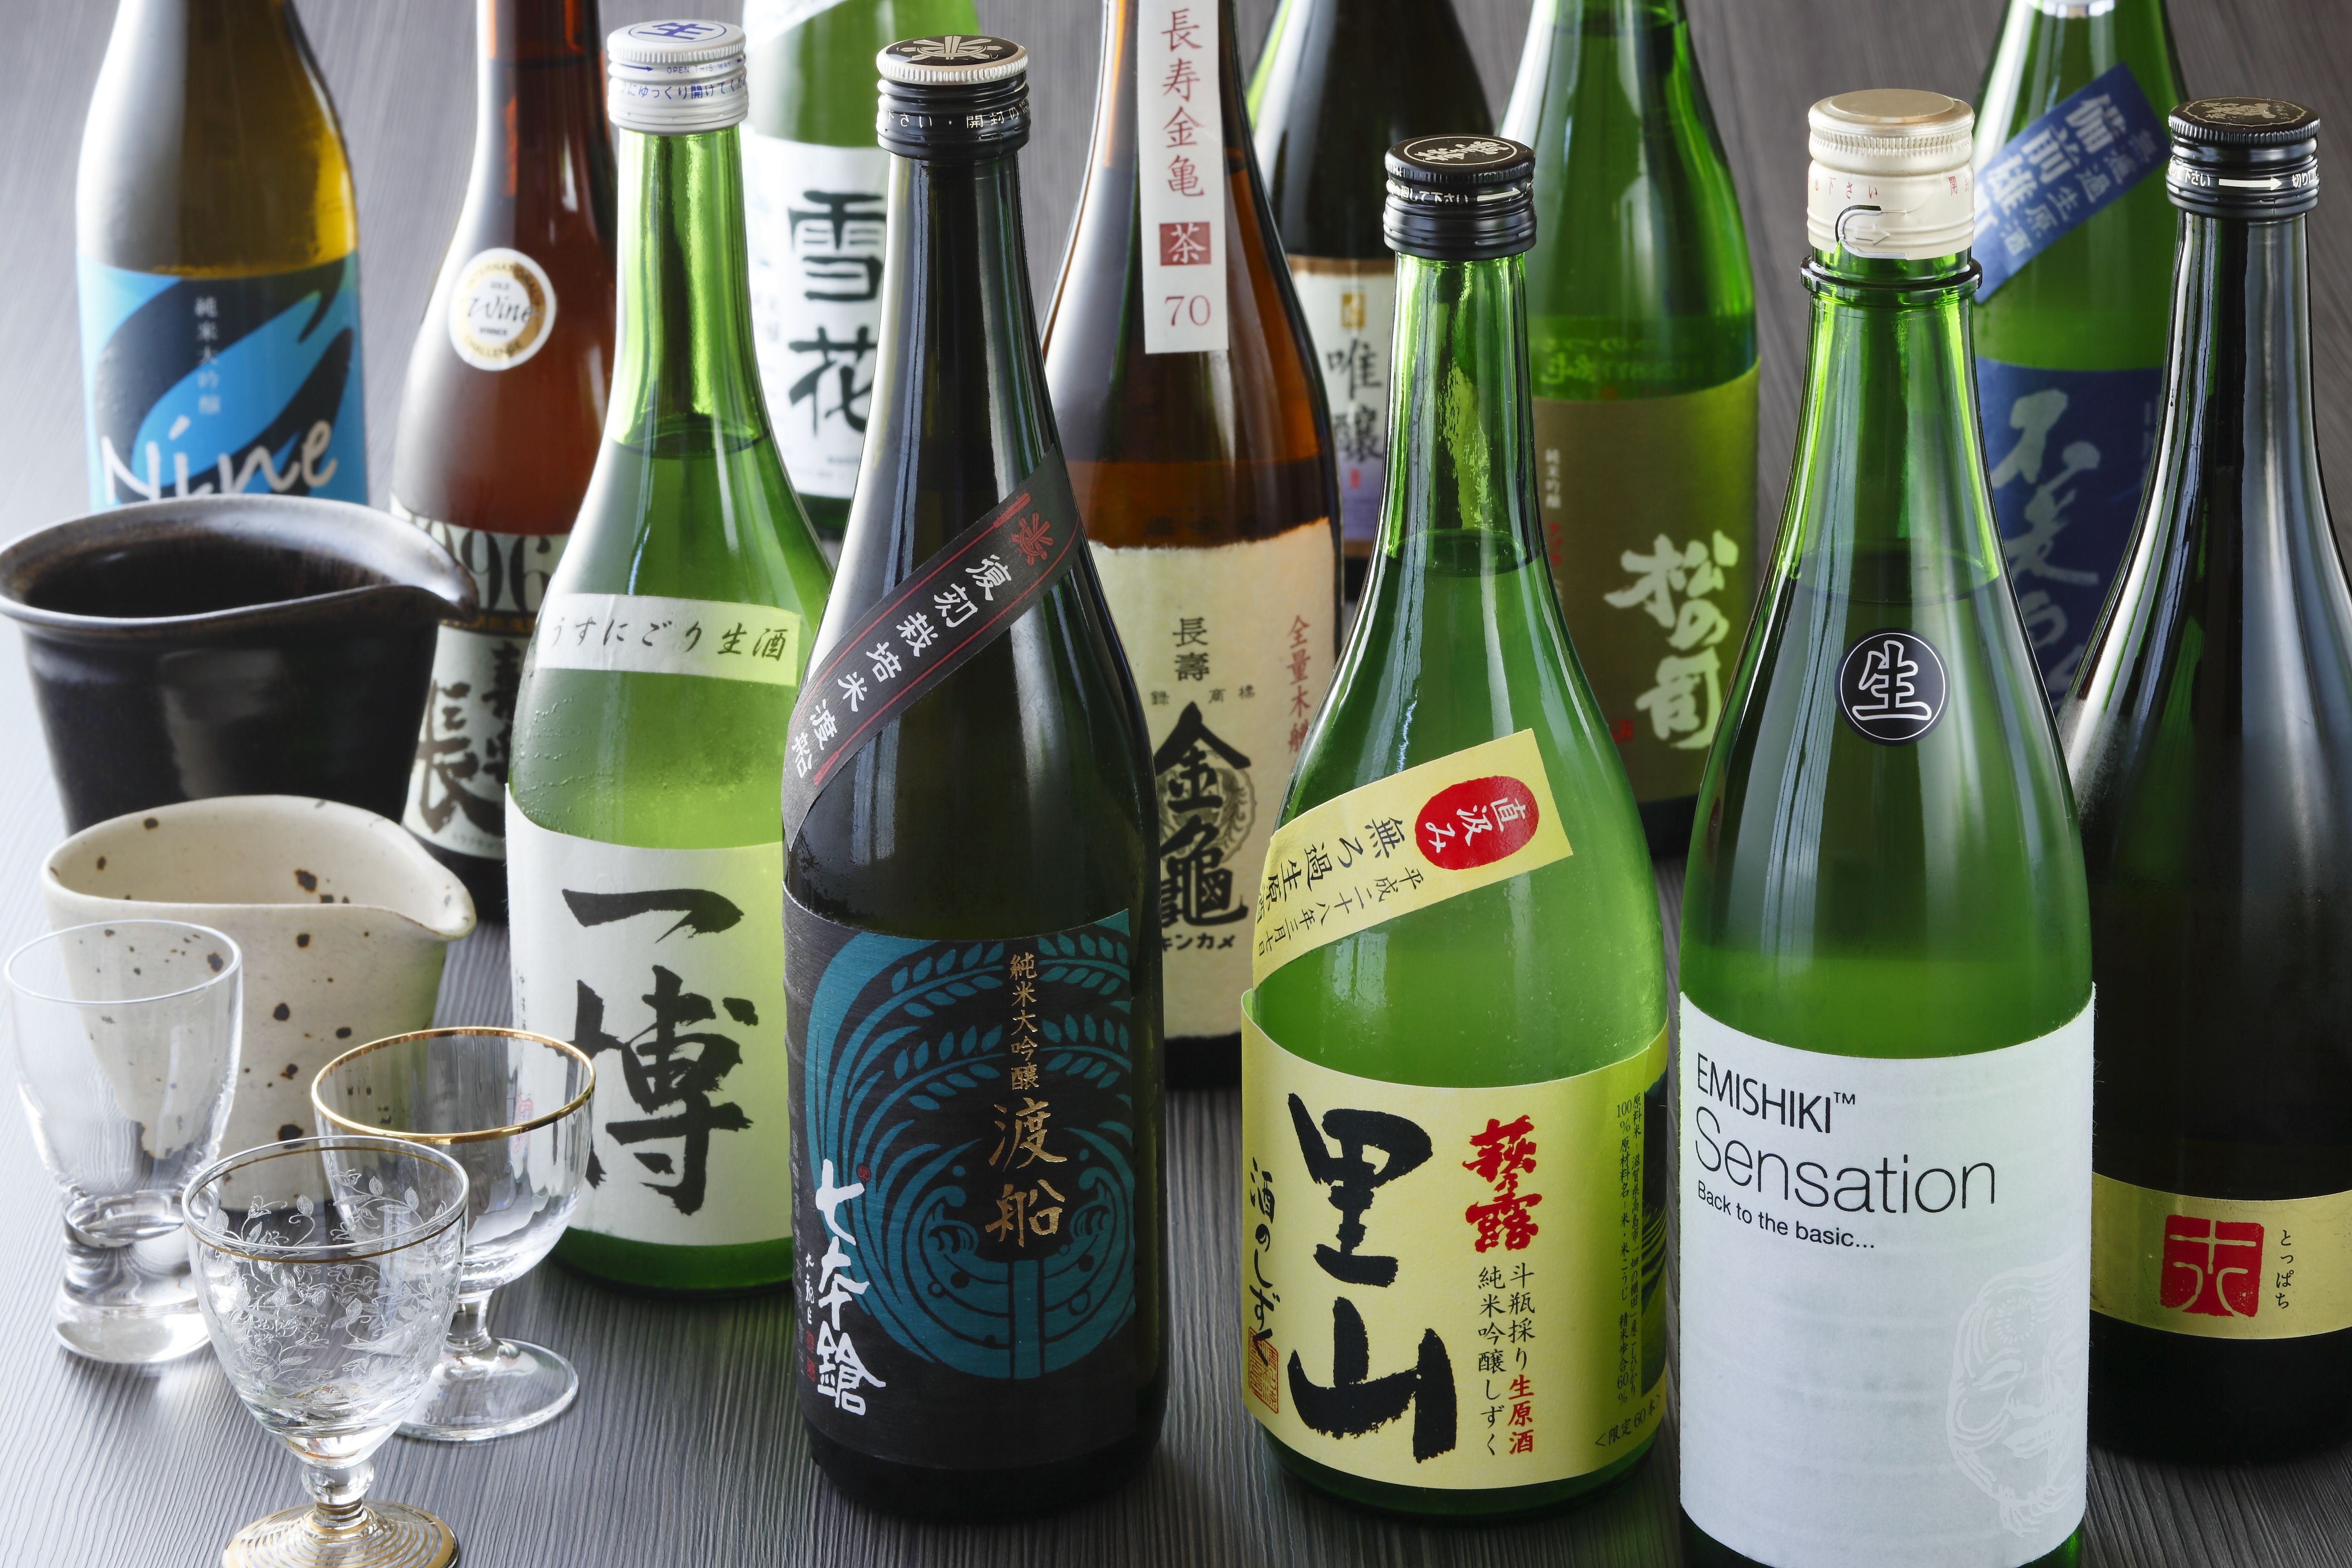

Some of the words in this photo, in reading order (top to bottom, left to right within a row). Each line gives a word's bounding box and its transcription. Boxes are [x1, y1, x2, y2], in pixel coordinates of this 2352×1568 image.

[667, 65, 690, 74] OPEN
[695, 64, 713, 73] THIS
[718, 61, 731, 69] WAY
[1168, 222, 1206, 263] 茶
[466, 294, 535, 324] Wine
[788, 190, 886, 437] 雪花
[1164, 295, 1211, 326] 70
[552, 616, 789, 662] うすにごり生酒
[1604, 529, 1739, 750] 松の司
[1852, 640, 1932, 720] 生
[1256, 817, 1405, 925] 無ろ過生原酒
[1426, 797, 1526, 853] 直汲み
[544, 888, 760, 1216] 一博
[1009, 952, 1039, 1090] 純米大吟醸
[985, 1097, 1068, 1248] 渡船
[1695, 1106, 1995, 1214] Sensation
[1698, 1180, 1731, 1213] Back
[1736, 1202, 1752, 1224] to
[1758, 1212, 1788, 1236] the
[1795, 1221, 1875, 1249] basic...
[1288, 1093, 1457, 1464] 里山
[2275, 1230, 2295, 1309] とっぱち
[1478, 1266, 1506, 1455] 純米吟醸しずく
